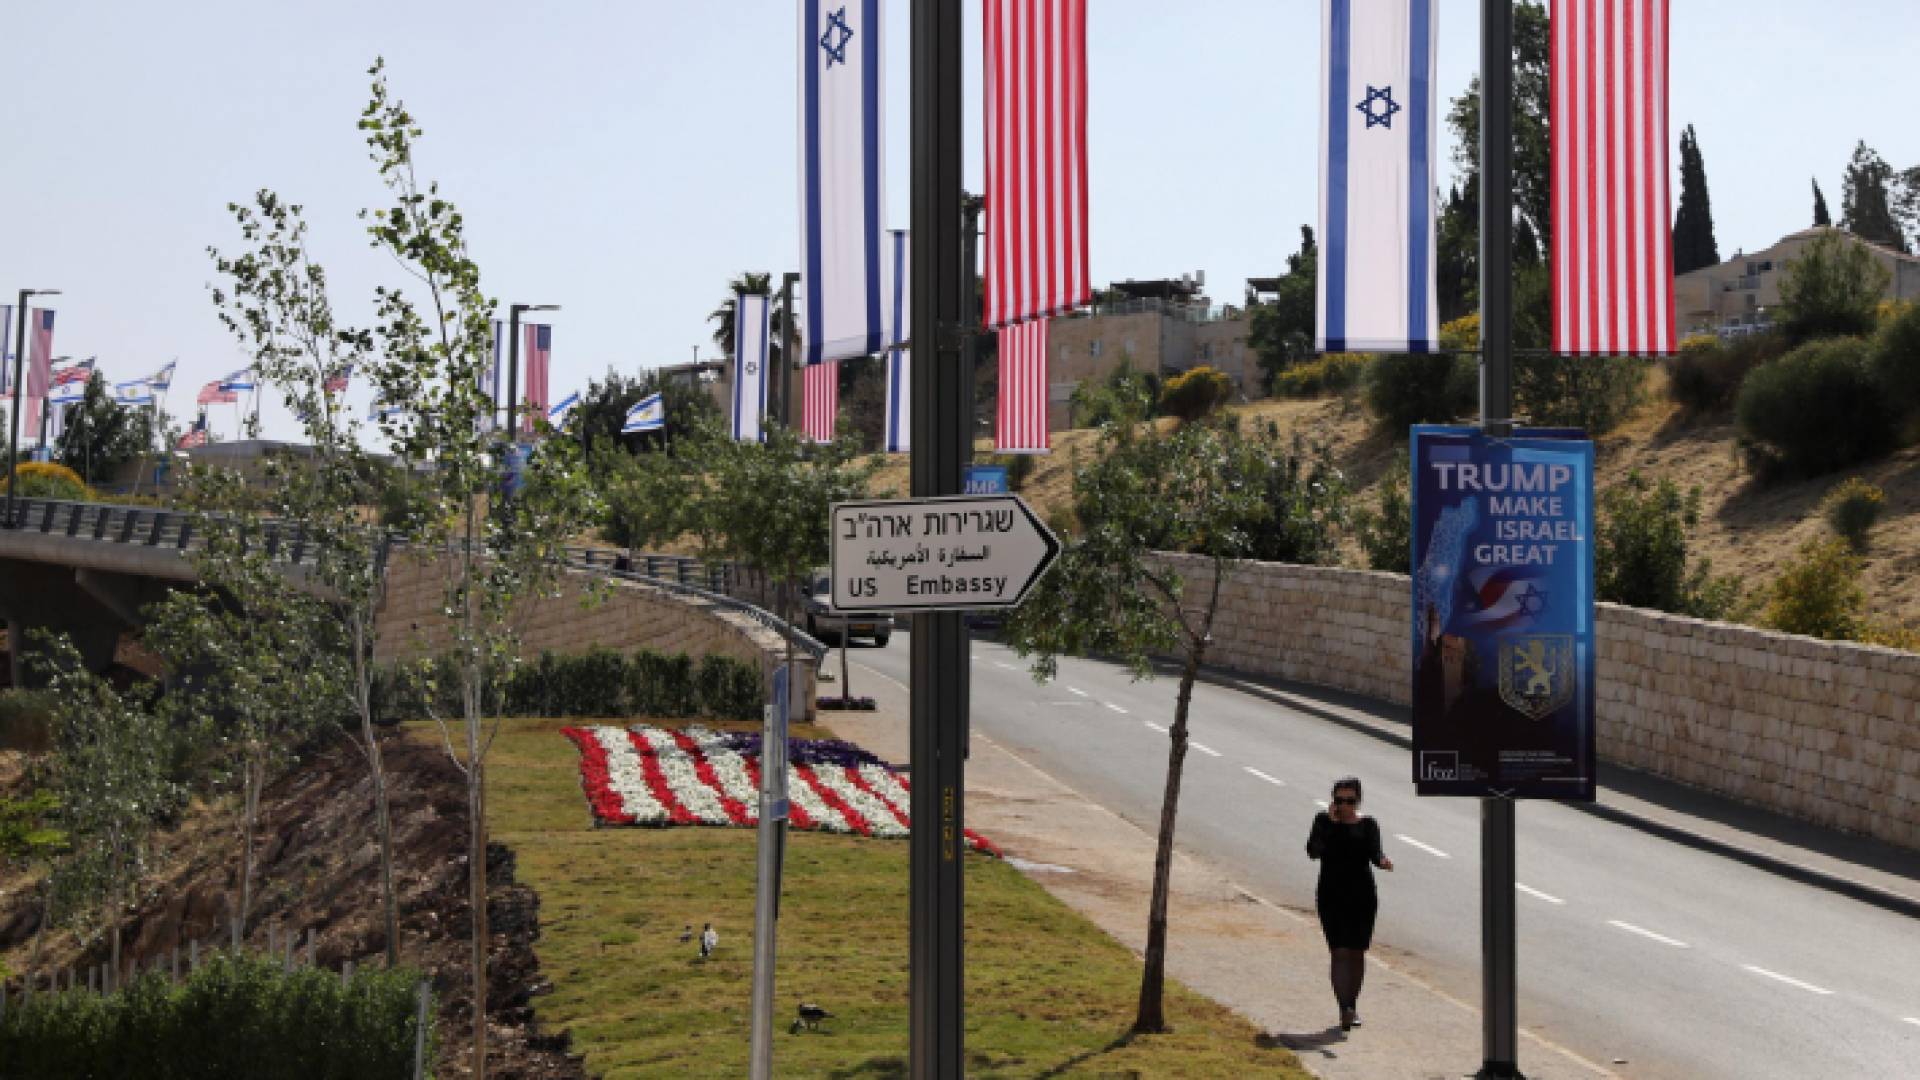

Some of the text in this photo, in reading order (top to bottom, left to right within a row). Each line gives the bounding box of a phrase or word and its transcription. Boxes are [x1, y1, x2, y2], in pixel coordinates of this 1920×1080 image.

[1431, 463, 1569, 492] TRUMP
[1489, 496, 1564, 516] MAKE
[924, 510, 1013, 536] שגרירות
[1496, 520, 1584, 541] ISRAEL
[939, 544, 991, 567] السفارة
[1474, 544, 1558, 565] GREAT
[848, 574, 1008, 597] US Embassy
